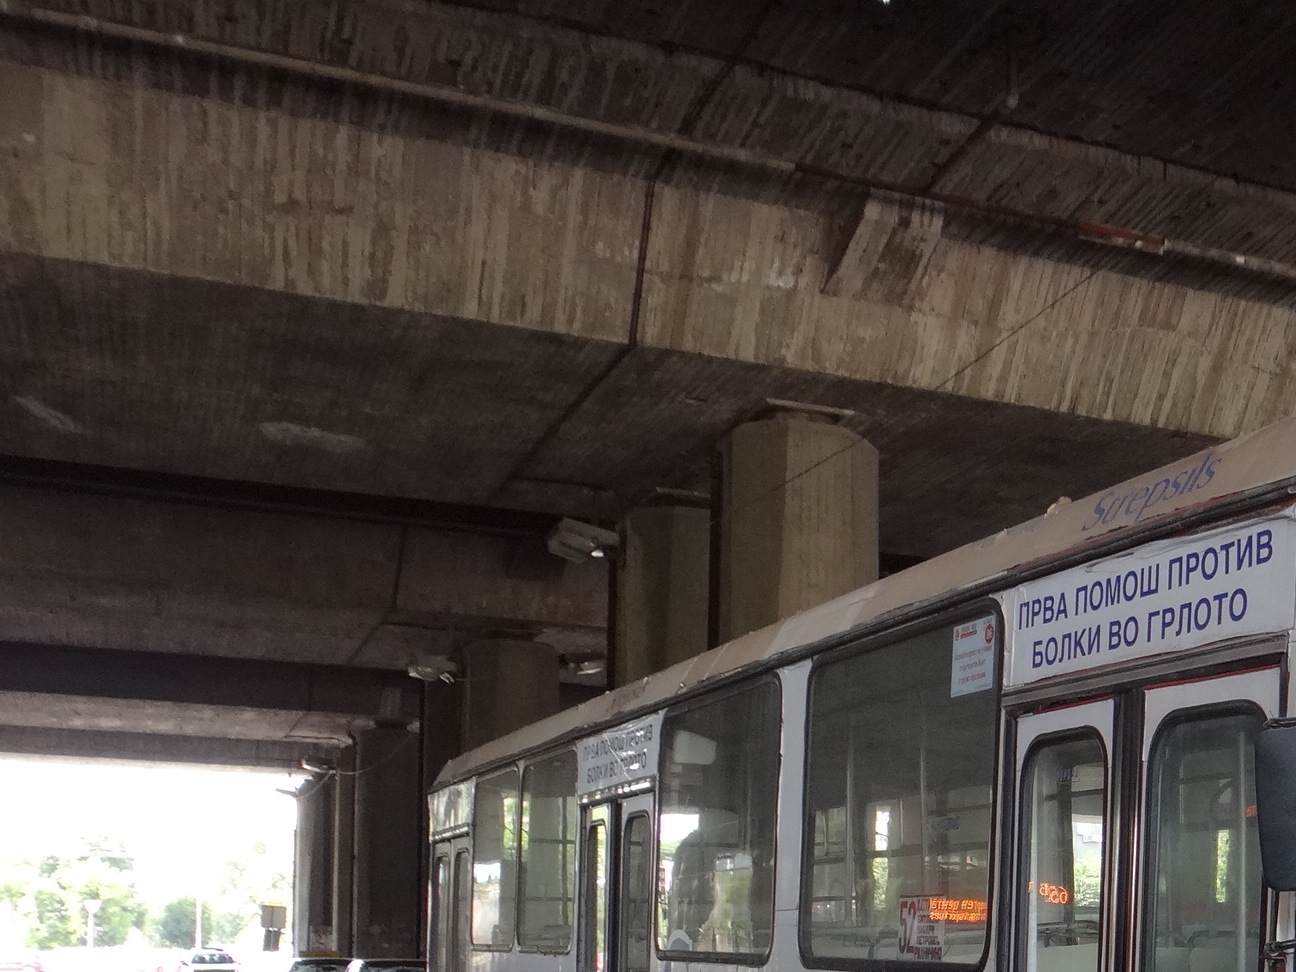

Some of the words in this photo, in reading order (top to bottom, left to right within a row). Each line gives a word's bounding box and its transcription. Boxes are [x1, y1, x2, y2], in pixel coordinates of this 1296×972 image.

[1081, 453, 1222, 531] Strepsils
[1018, 592, 1068, 630] ПРВА
[1074, 563, 1160, 616] ПОМОШ
[1167, 529, 1273, 590] ПРОТИВ
[1031, 624, 1101, 669] БОЛКИ
[1108, 616, 1139, 650] ВО
[1147, 588, 1248, 643] ГРЛОТО
[899, 900, 917, 954] 52
